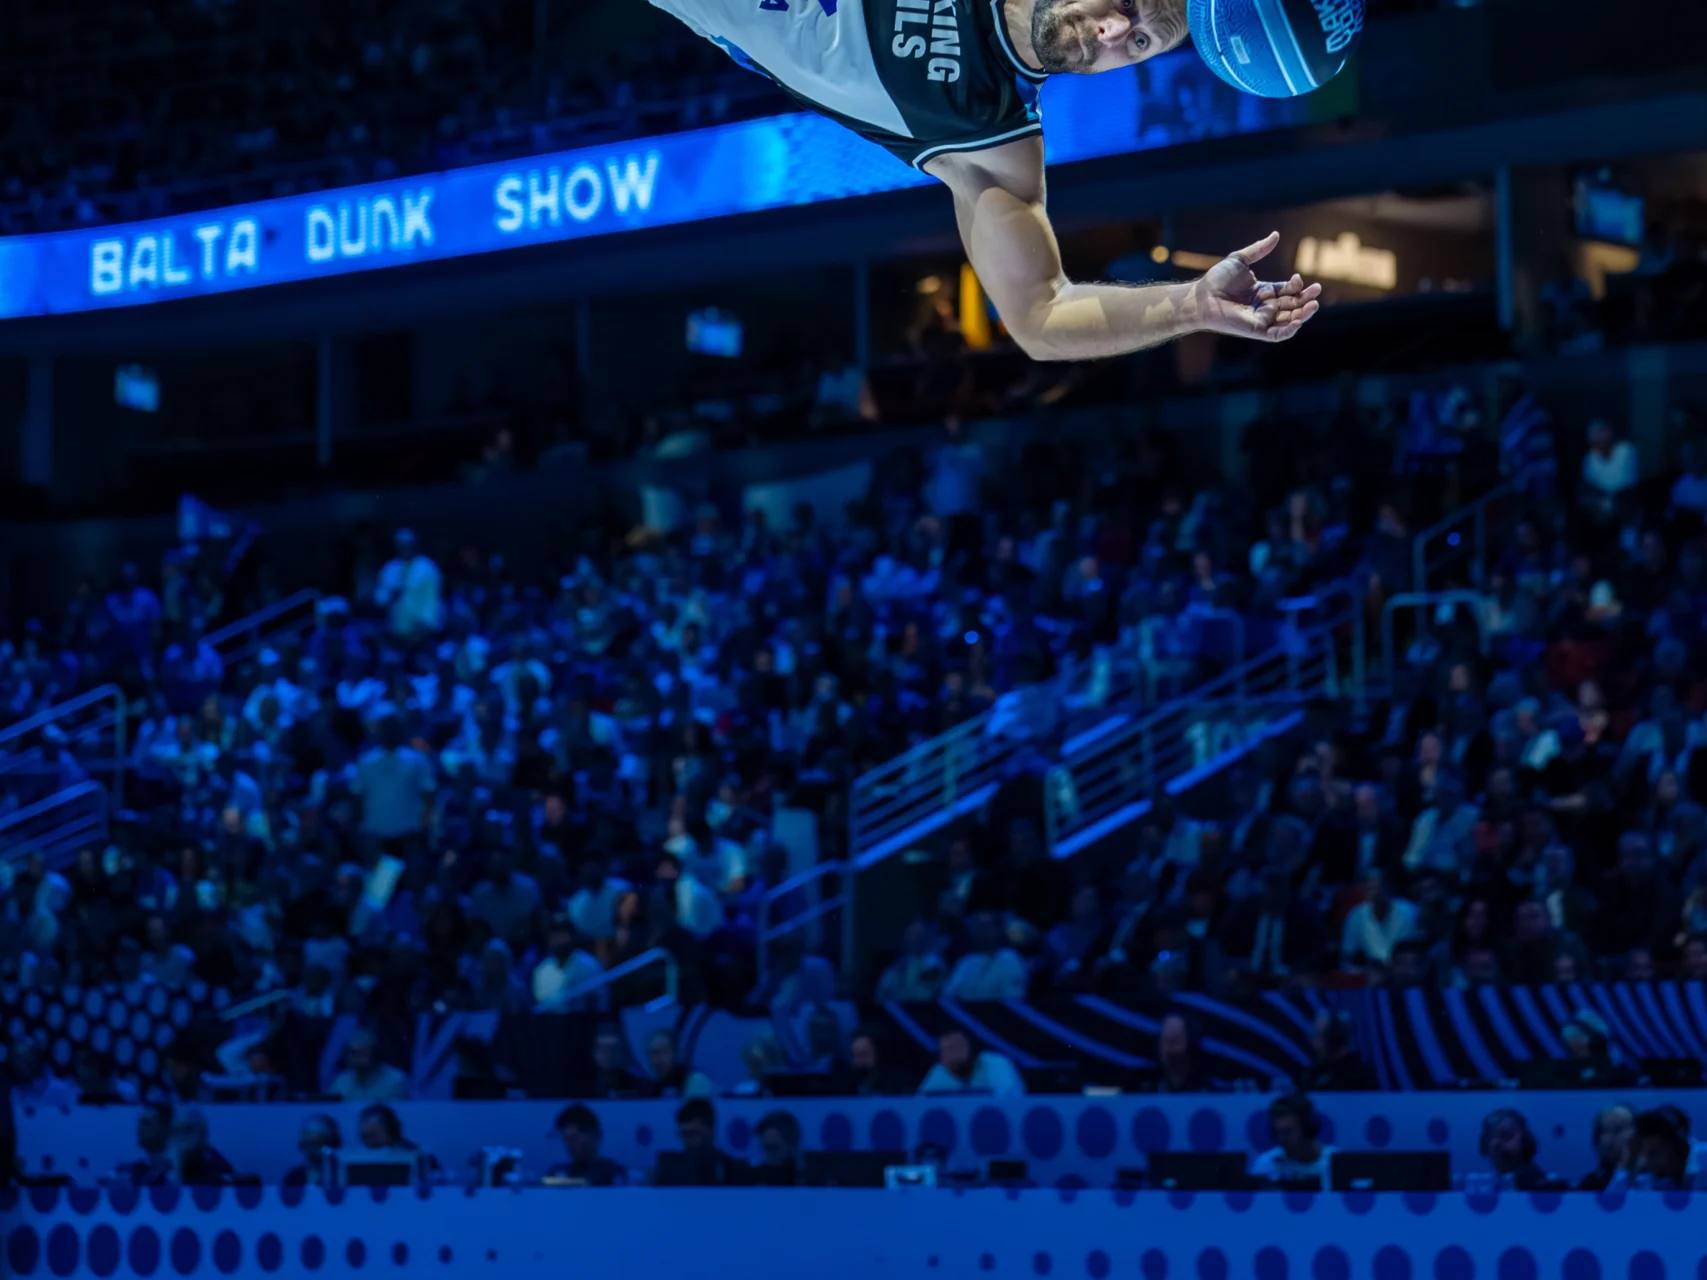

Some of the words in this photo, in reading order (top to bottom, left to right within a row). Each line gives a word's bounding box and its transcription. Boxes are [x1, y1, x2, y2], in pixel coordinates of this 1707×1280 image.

[90, 219, 258, 294] BALTA
[307, 191, 435, 262] DUNK
[495, 152, 660, 232] SHOW
